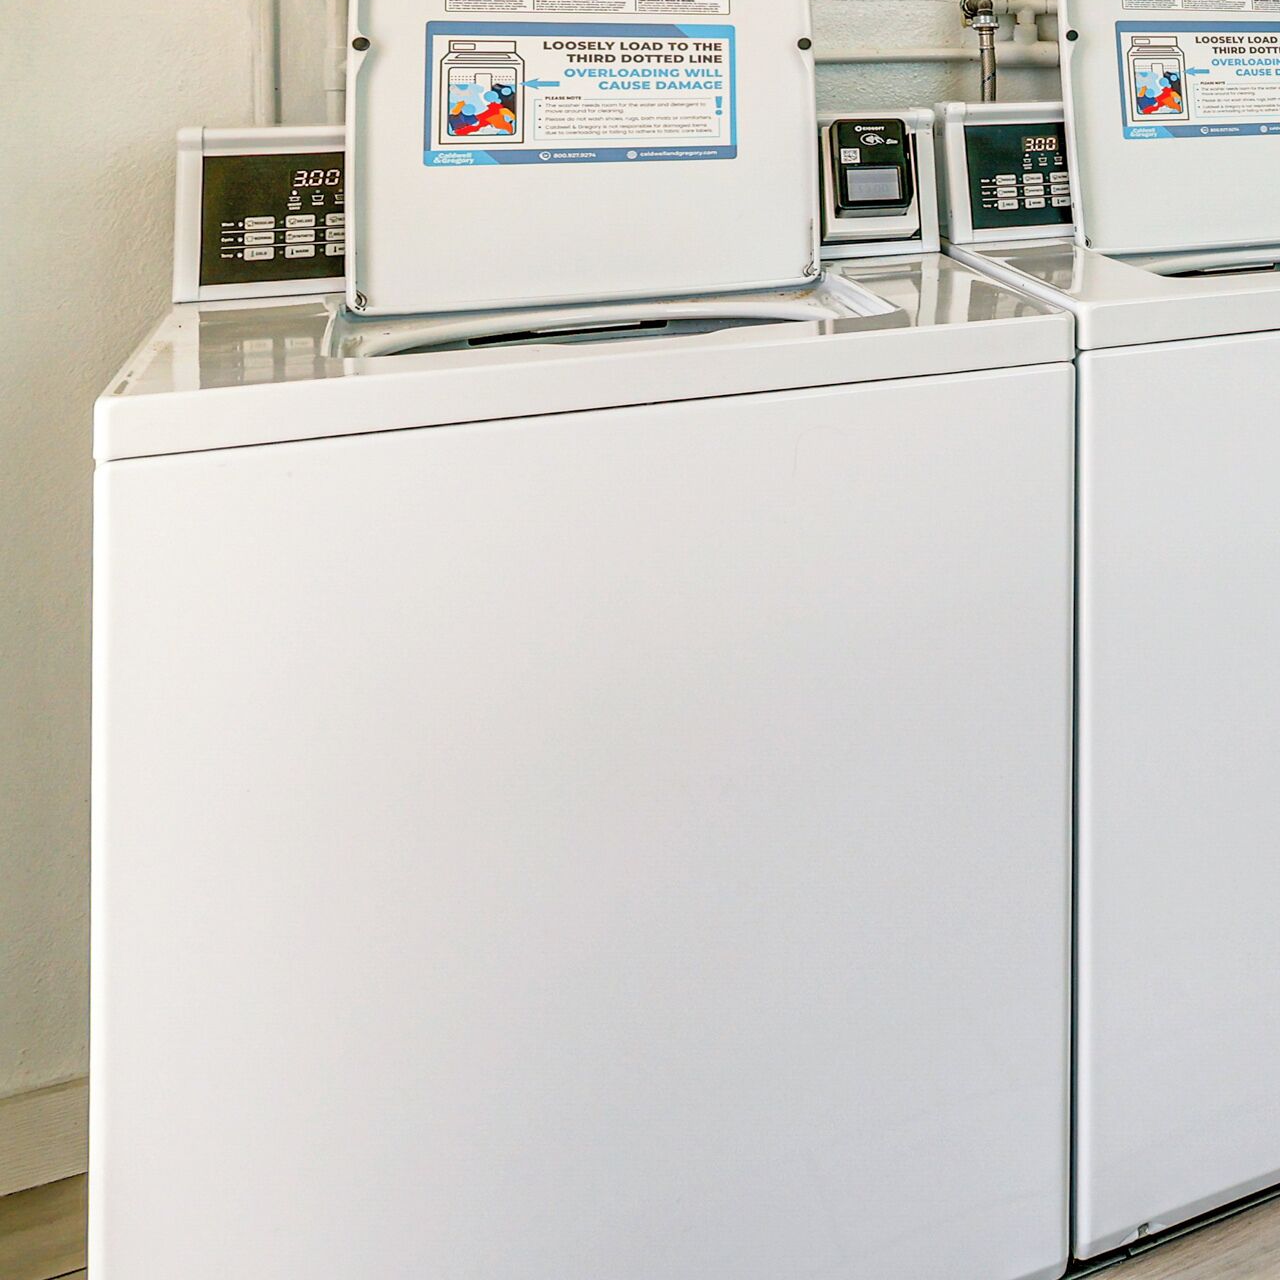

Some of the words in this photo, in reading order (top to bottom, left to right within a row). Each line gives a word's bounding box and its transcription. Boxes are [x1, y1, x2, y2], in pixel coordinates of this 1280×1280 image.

[1195, 36, 1245, 44] LOOSELY
[1247, 36, 1278, 44] LOAD
[543, 40, 616, 51] LOOSELY
[620, 41, 663, 51] LOAD
[667, 42, 689, 51] TO
[693, 42, 722, 52] THE
[1212, 46, 1246, 54] THIRD
[566, 53, 616, 63] THIRD
[621, 54, 684, 63] DOTTED
[689, 54, 722, 64] LINE
[564, 68, 680, 78] OVERLOADING
[684, 68, 723, 78] WILL
[1235, 68, 1272, 76] CAUSE
[598, 80, 651, 90] CAUSE
[655, 80, 722, 90] DAMAGE
[1025, 137, 1056, 152] 3.00
[433, 156, 474, 164] &Gregory
[293, 168, 341, 187] 3.00
